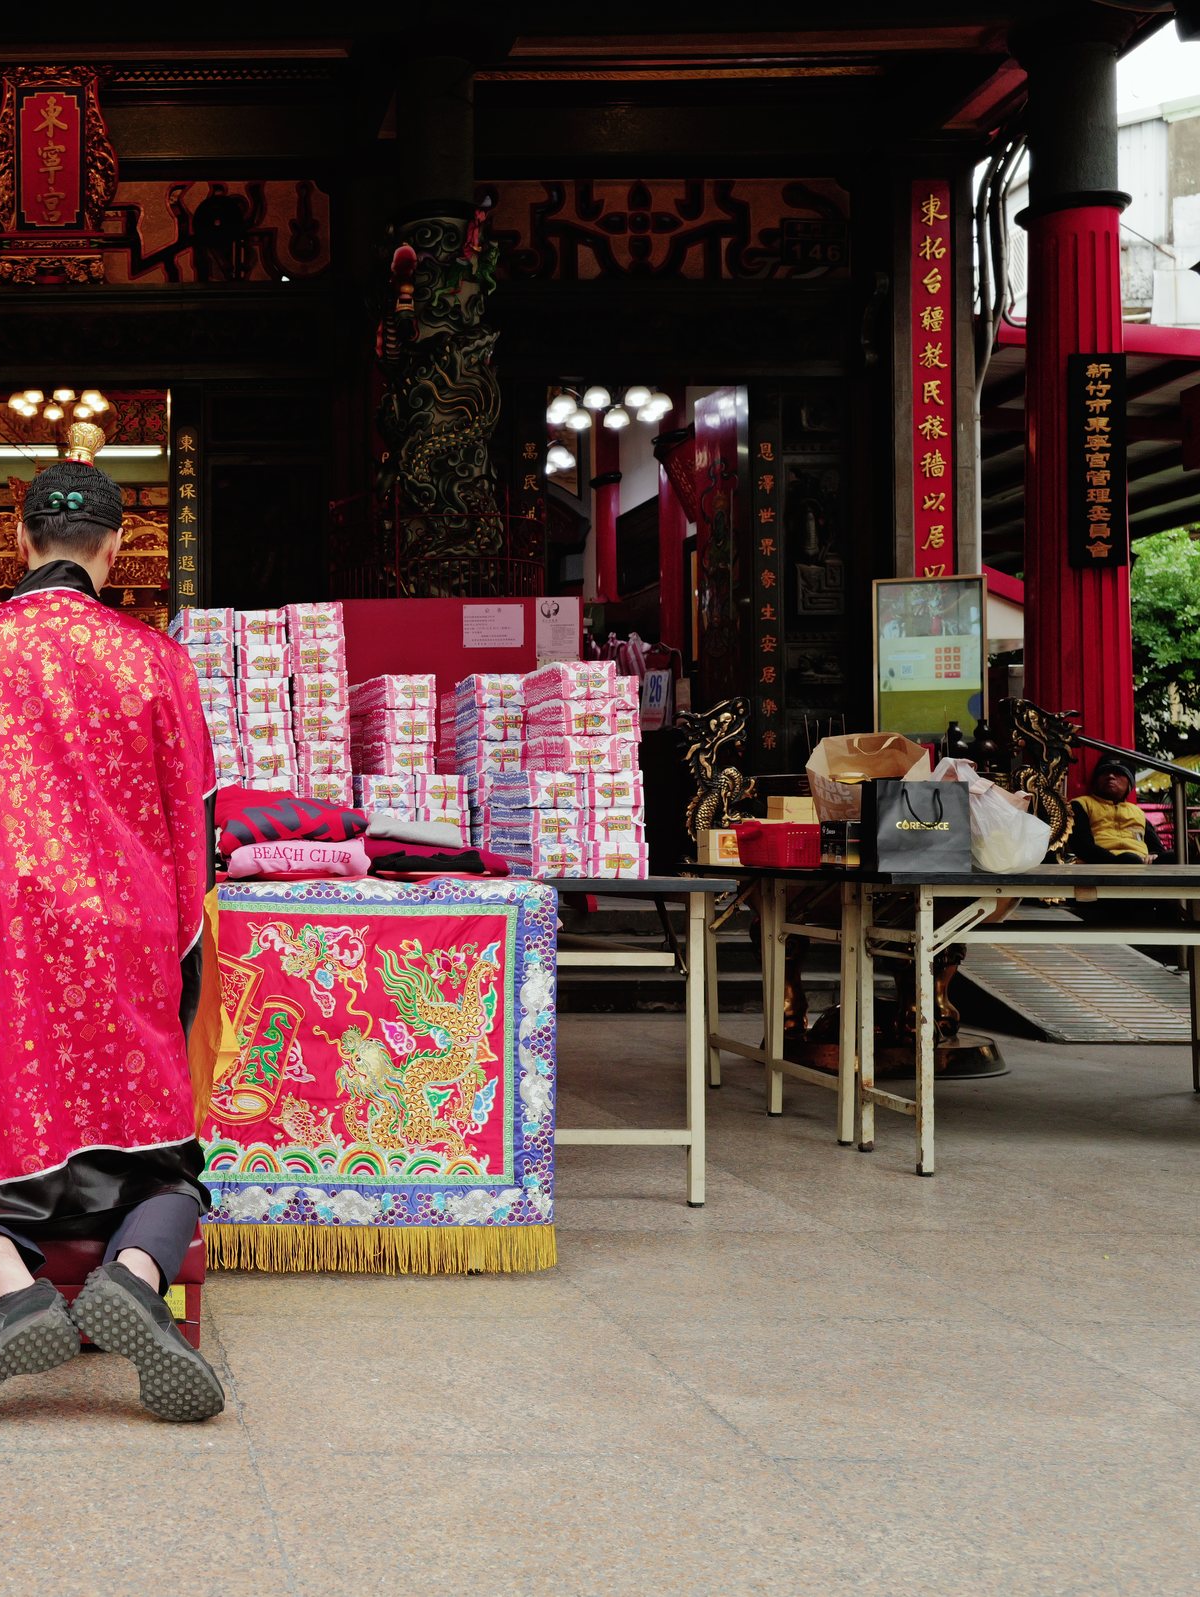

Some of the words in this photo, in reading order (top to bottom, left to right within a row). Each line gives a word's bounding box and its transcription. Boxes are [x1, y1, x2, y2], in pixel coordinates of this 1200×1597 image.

[32, 95, 68, 223] 東寧宮
[177, 434, 197, 610] 東瀛保泰平遐邇
[1084, 362, 1113, 559] 新竹市東寧宮管理委員會
[648, 674, 662, 703] 26
[253, 846, 304, 862] BEACH
[309, 848, 352, 865] CLUB
